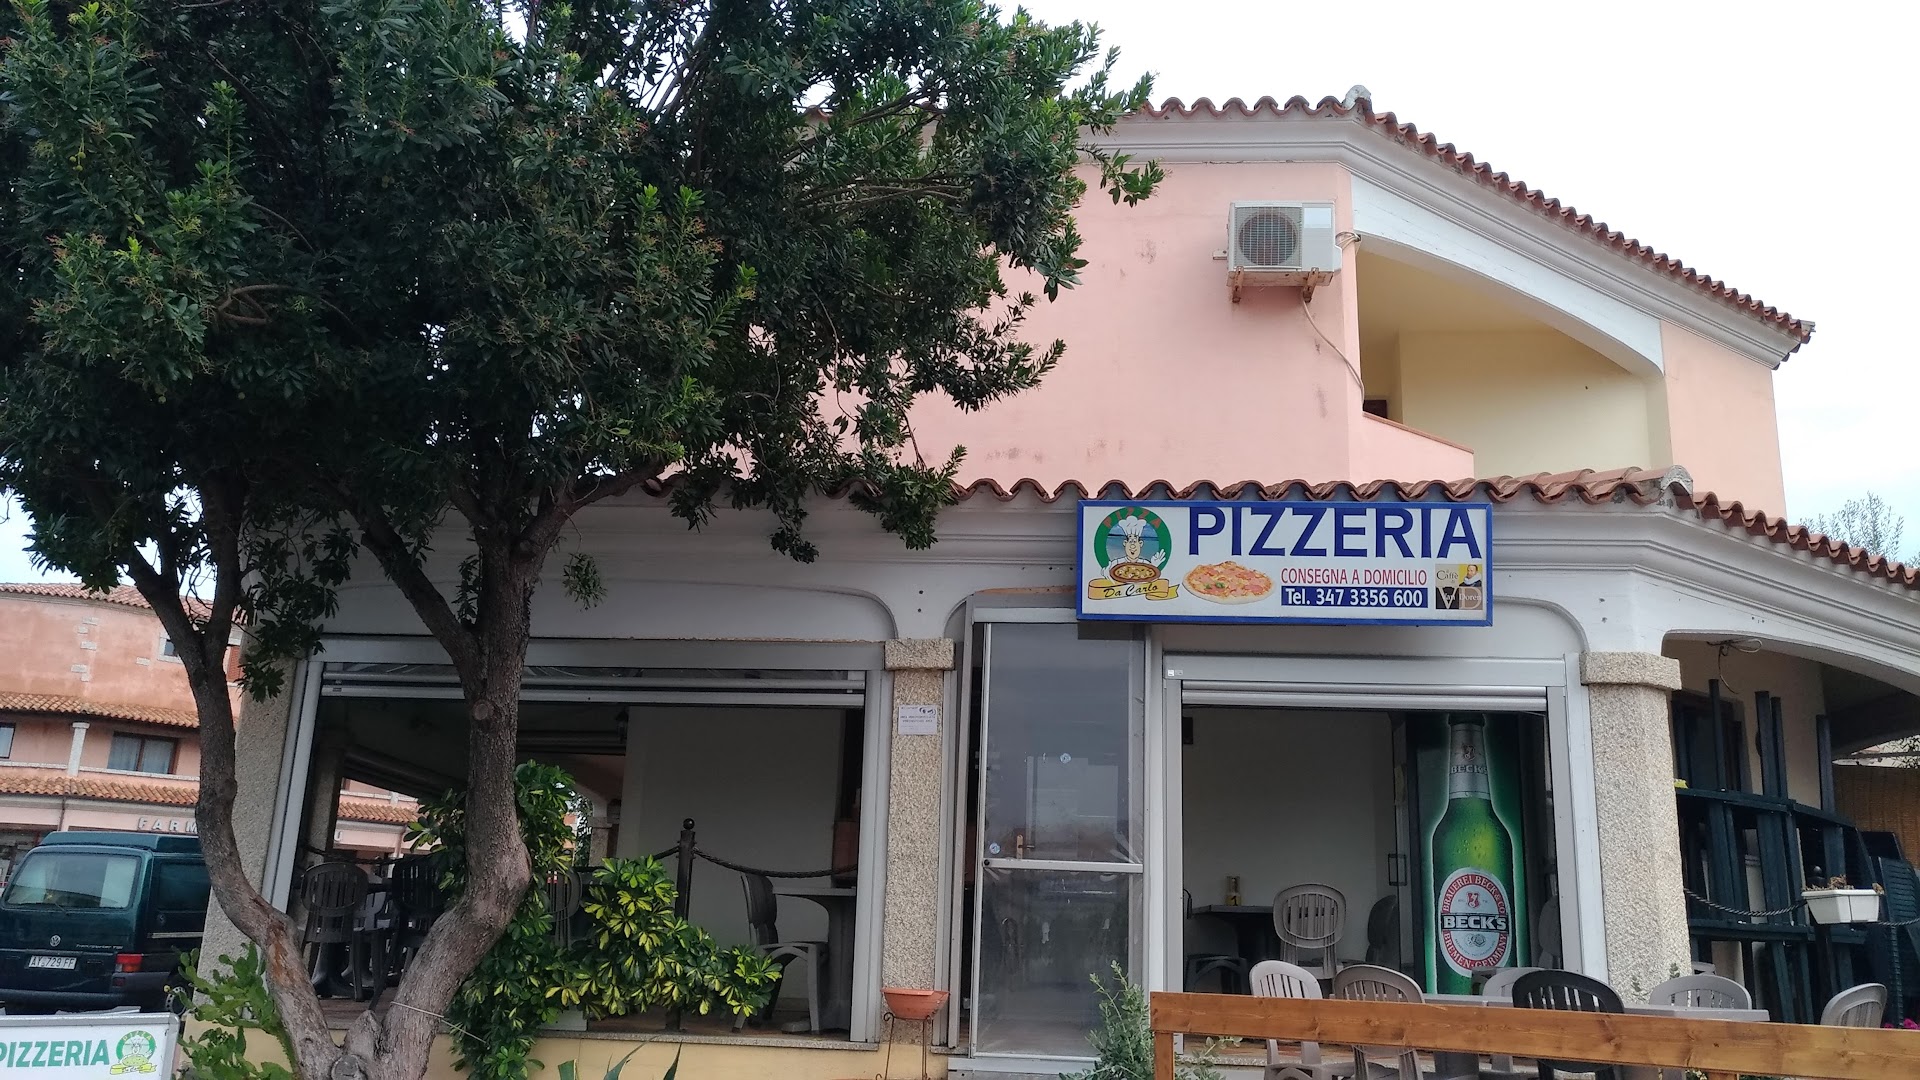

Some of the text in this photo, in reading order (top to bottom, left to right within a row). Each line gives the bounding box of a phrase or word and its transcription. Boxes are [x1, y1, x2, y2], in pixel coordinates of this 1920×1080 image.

[1189, 507, 1482, 558] PIZZERIA
[1281, 568, 1427, 585] CONSEGNA A DOMICILIO
[1103, 583, 1158, 597] Da Carlo
[1285, 588, 1423, 607] Tel. 347 3356 600
[1442, 875, 1474, 912] BRAUEREI
[1475, 875, 1498, 895] BECK
[1443, 915, 1507, 930] BECK'S
